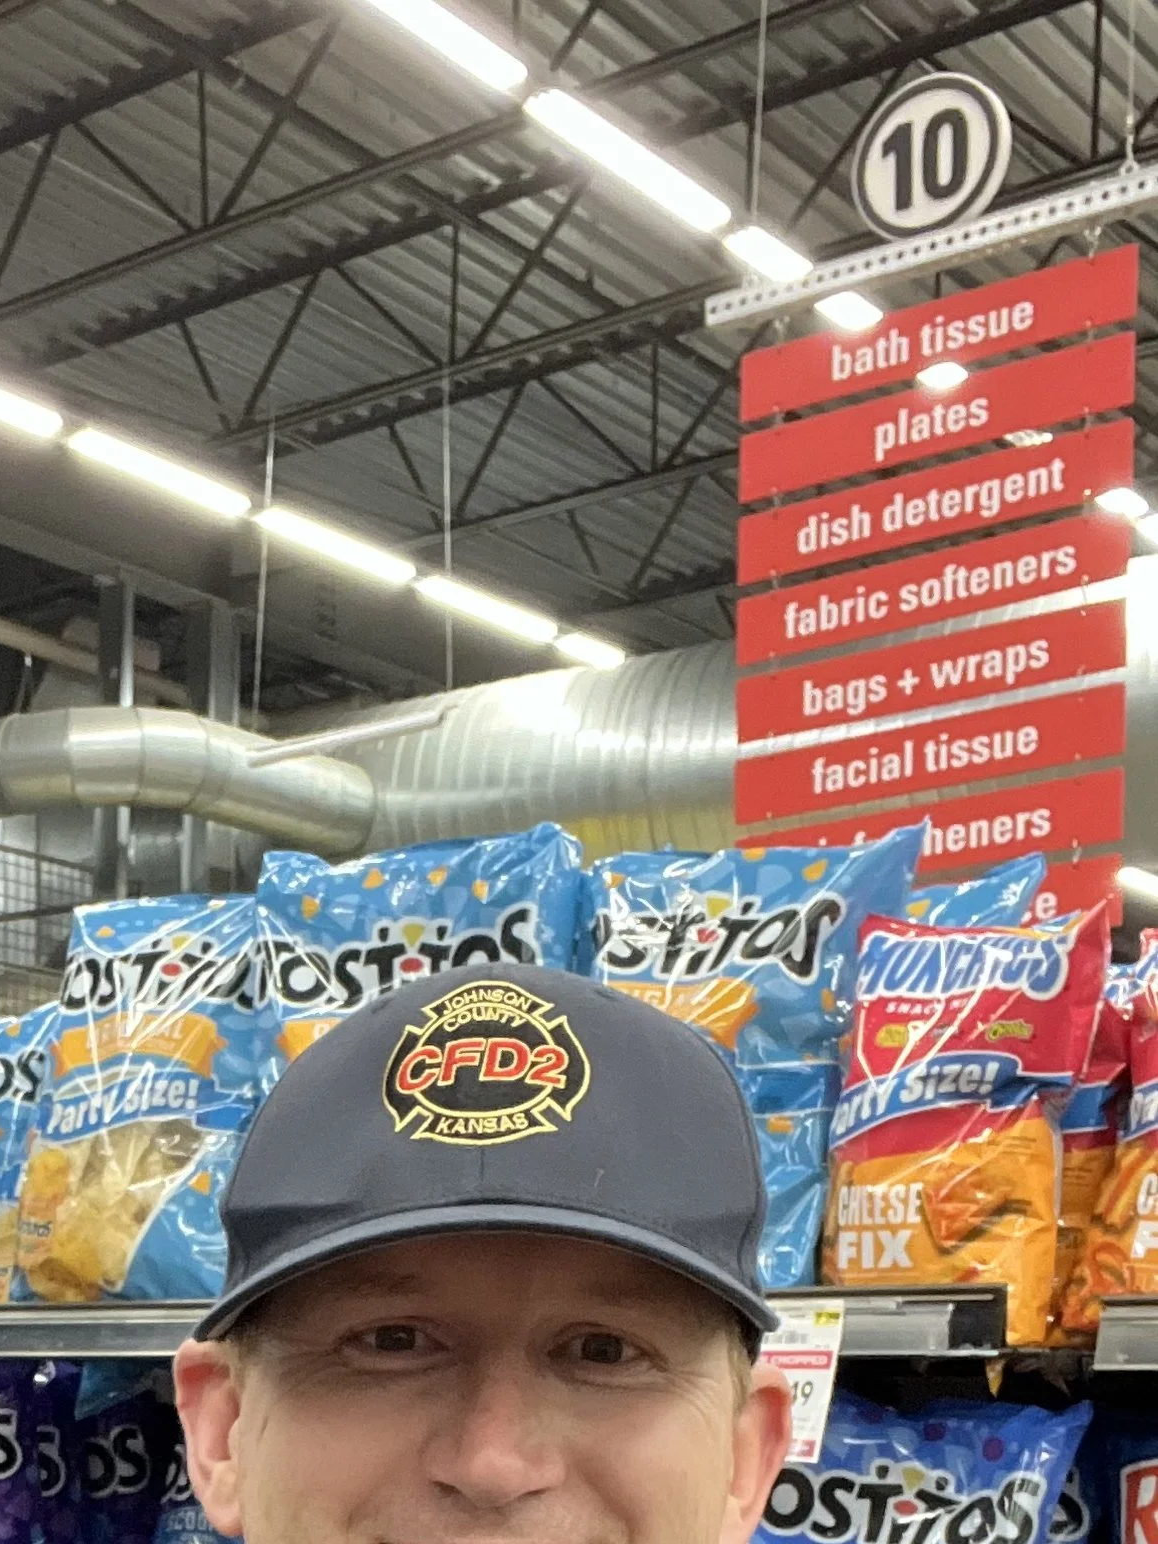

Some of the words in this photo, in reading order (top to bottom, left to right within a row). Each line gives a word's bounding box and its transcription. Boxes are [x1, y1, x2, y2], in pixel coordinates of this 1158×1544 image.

[881, 107, 969, 212] 10
[831, 328, 910, 381] bath
[921, 300, 1035, 351] tissue
[874, 397, 990, 462] plates
[797, 505, 871, 555] dish
[882, 457, 1065, 532] detergent
[785, 586, 889, 638] fabric
[899, 545, 1078, 611] softeners
[802, 671, 887, 717] bags
[896, 668, 919, 694] +
[930, 638, 1050, 690] wraps
[812, 740, 913, 794] facial
[924, 725, 1039, 772] tissue
[922, 808, 1052, 857] heners
[442, 988, 532, 1017] JOHNSON
[443, 1005, 528, 1032] COUNTY
[123, 1078, 200, 1113] Size!
[395, 1037, 570, 1095] CFD2
[434, 1112, 530, 1136] KANSAS
[835, 1078, 898, 1134] arty
[900, 1061, 999, 1103] Size!
[838, 1181, 923, 1226] CHEESE
[837, 1229, 913, 1269] FIX
